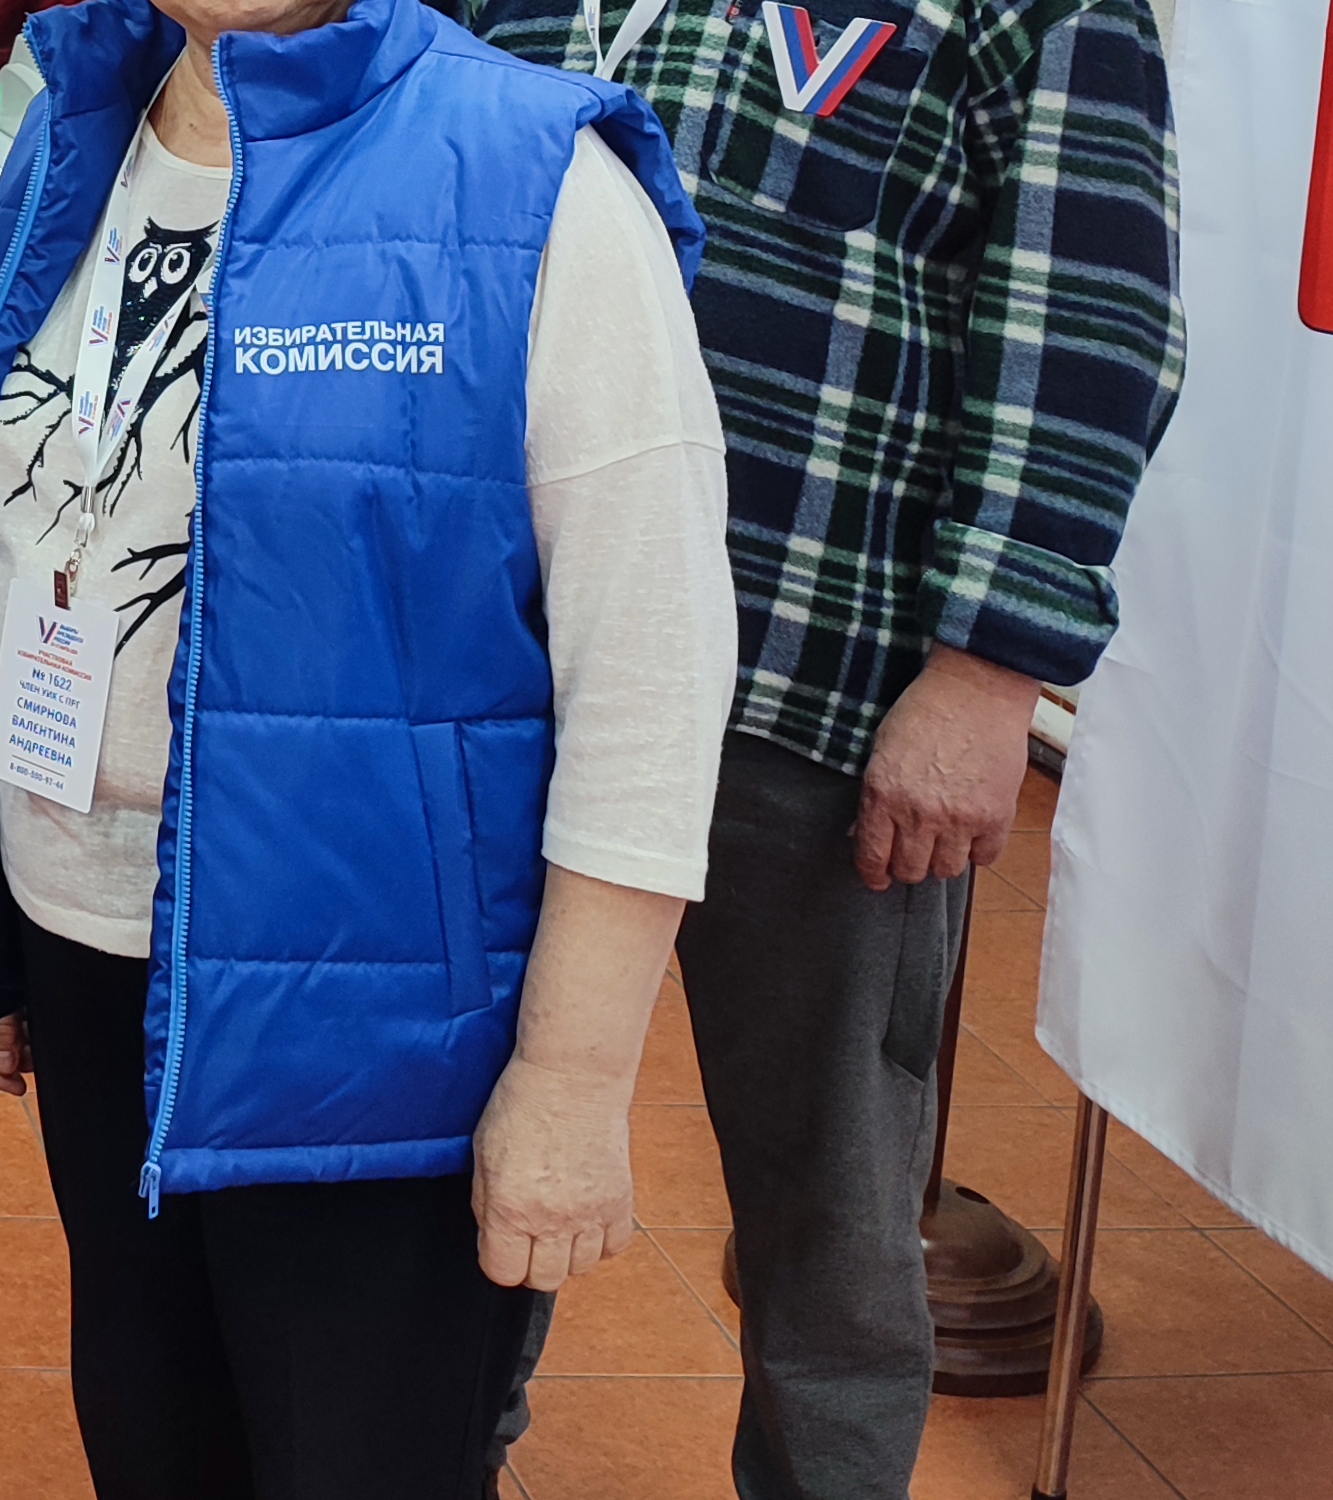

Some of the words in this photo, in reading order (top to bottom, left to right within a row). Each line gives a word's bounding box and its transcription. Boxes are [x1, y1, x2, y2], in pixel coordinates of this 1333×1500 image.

[235, 320, 445, 346] ИЗБИРАТЕЛЬНАЯ
[235, 342, 444, 375] КОМИССИЯ
[19, 679, 40, 695] ЧЛЕН
[41, 687, 58, 701] УИК
[32, 667, 46, 681] №
[48, 672, 72, 692] 1622
[16, 696, 77, 730] СМИРНОВА
[11, 714, 76, 748] ВАЛЕНТИНА
[8, 734, 72, 768] АНДРЕЕВНА
